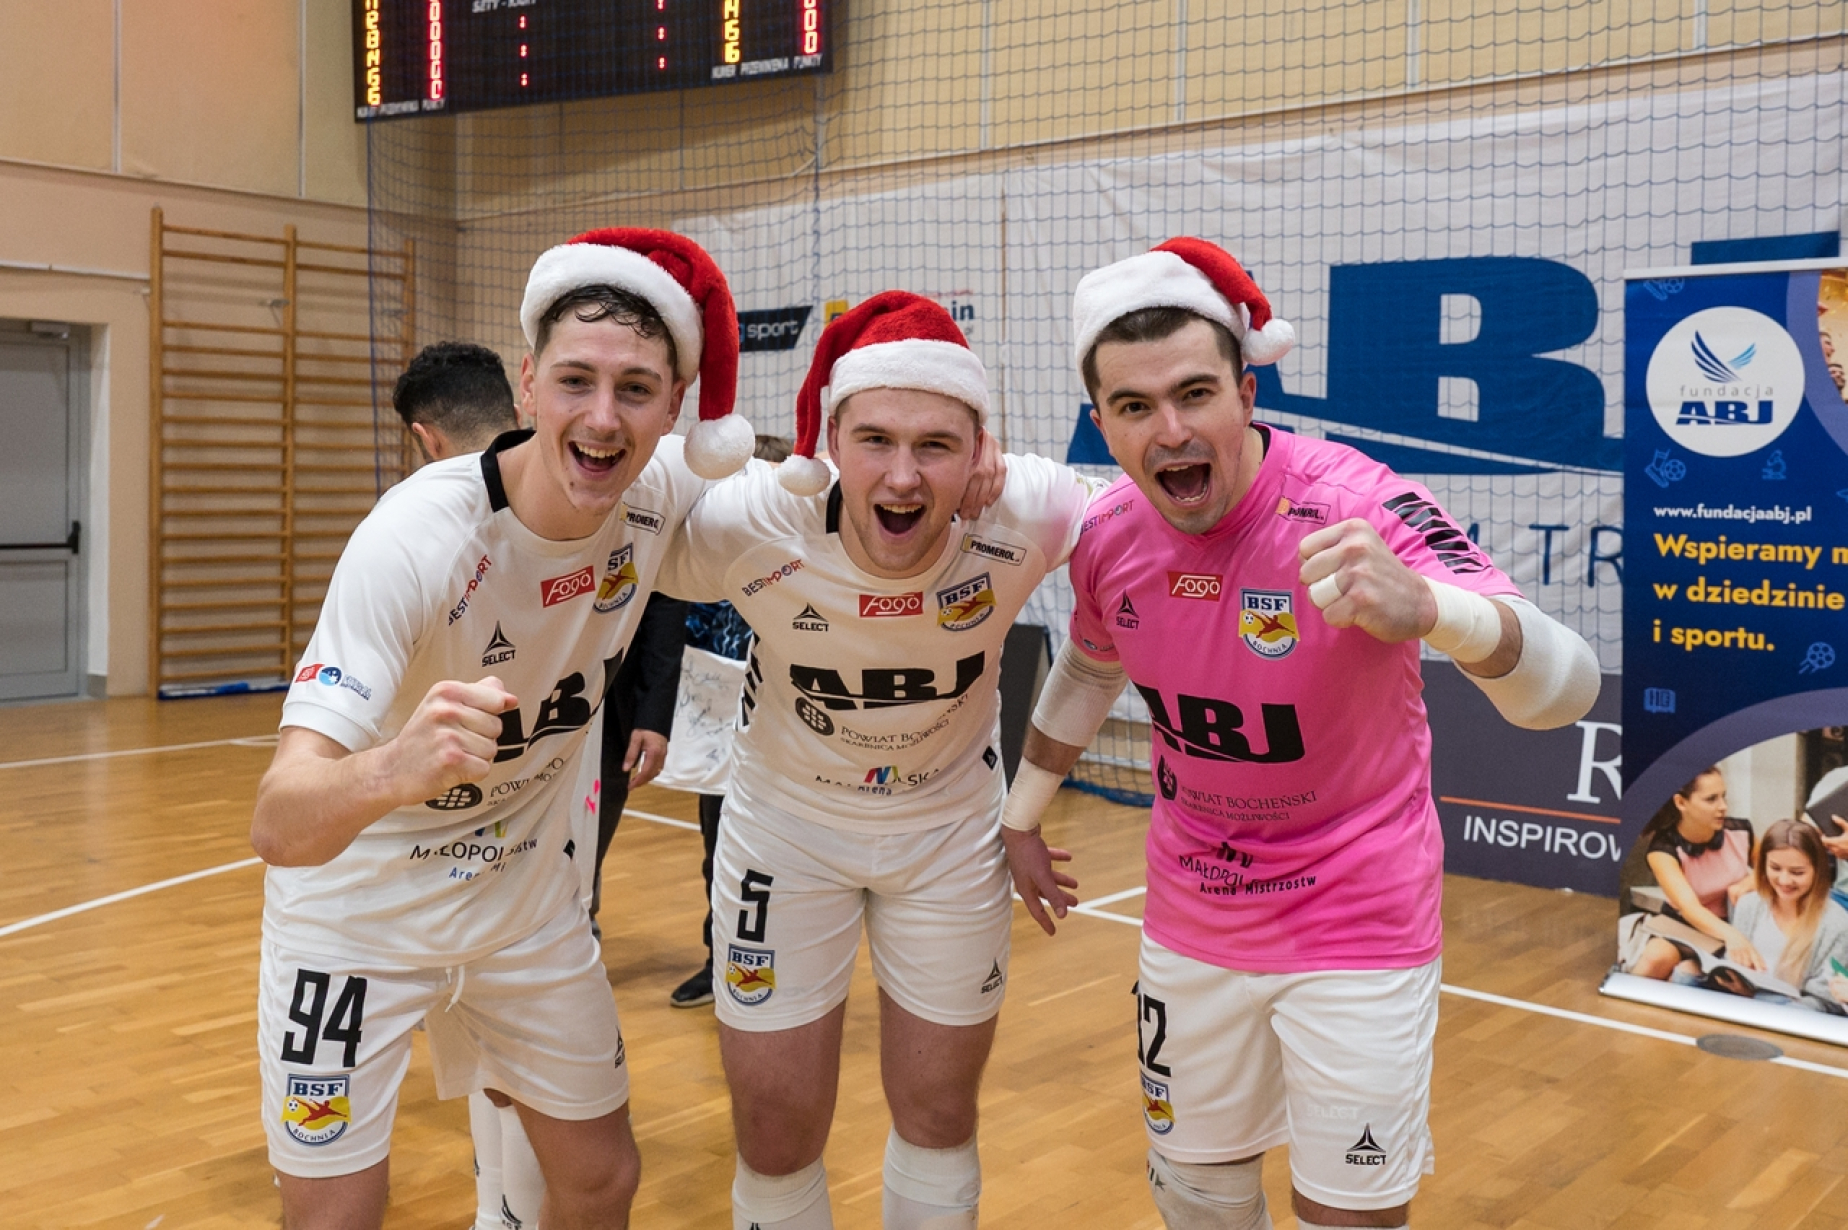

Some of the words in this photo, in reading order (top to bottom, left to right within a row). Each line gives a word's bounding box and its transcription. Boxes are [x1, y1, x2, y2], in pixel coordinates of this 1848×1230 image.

[1680, 384, 1774, 399] fundacja
[1675, 400, 1773, 425] ABJ
[1653, 503, 1812, 524] www.fundacjaabj.pl
[1653, 533, 1822, 570] Wspieramy
[1653, 582, 1678, 600] w
[1686, 576, 1845, 610] dziedzinie
[1247, 596, 1287, 611] BSF
[792, 621, 829, 632] SELECT
[1653, 619, 1661, 642] i
[1671, 627, 1775, 651] sportu.
[482, 650, 516, 667] SELECT
[790, 651, 985, 711] ABJ
[841, 726, 897, 743] POWIAT
[1226, 790, 1317, 809] BOCHEŃSKI
[1246, 876, 1316, 895] Mistrzostw
[737, 869, 774, 943] 5
[732, 951, 769, 966] BSF
[280, 968, 367, 1068] 94
[293, 1082, 342, 1096] BSF
[1345, 1154, 1387, 1166] SELECT
